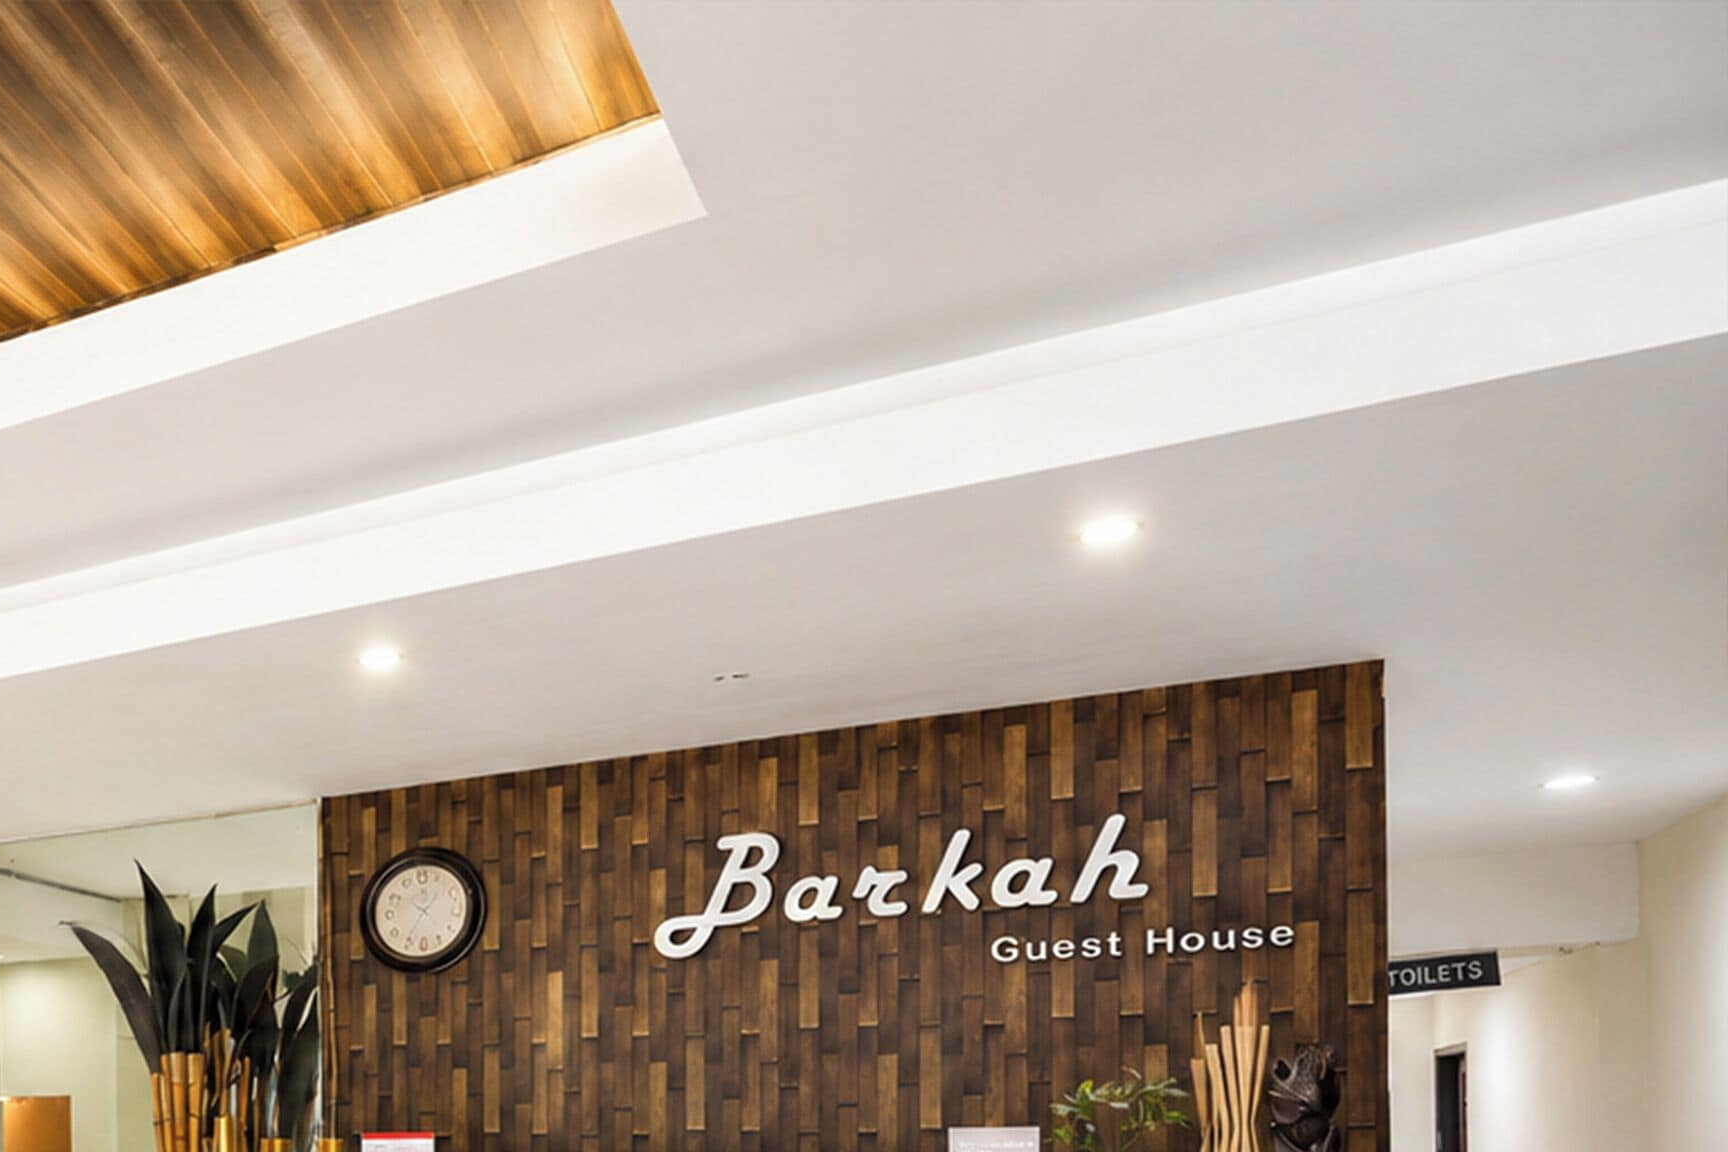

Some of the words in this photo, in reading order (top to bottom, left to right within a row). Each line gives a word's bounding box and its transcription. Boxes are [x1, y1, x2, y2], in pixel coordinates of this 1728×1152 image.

[654, 813, 1149, 959] Barkah
[990, 931, 1121, 964] Guest
[1146, 923, 1296, 956] House
[1387, 960, 1484, 987] TOILETS
